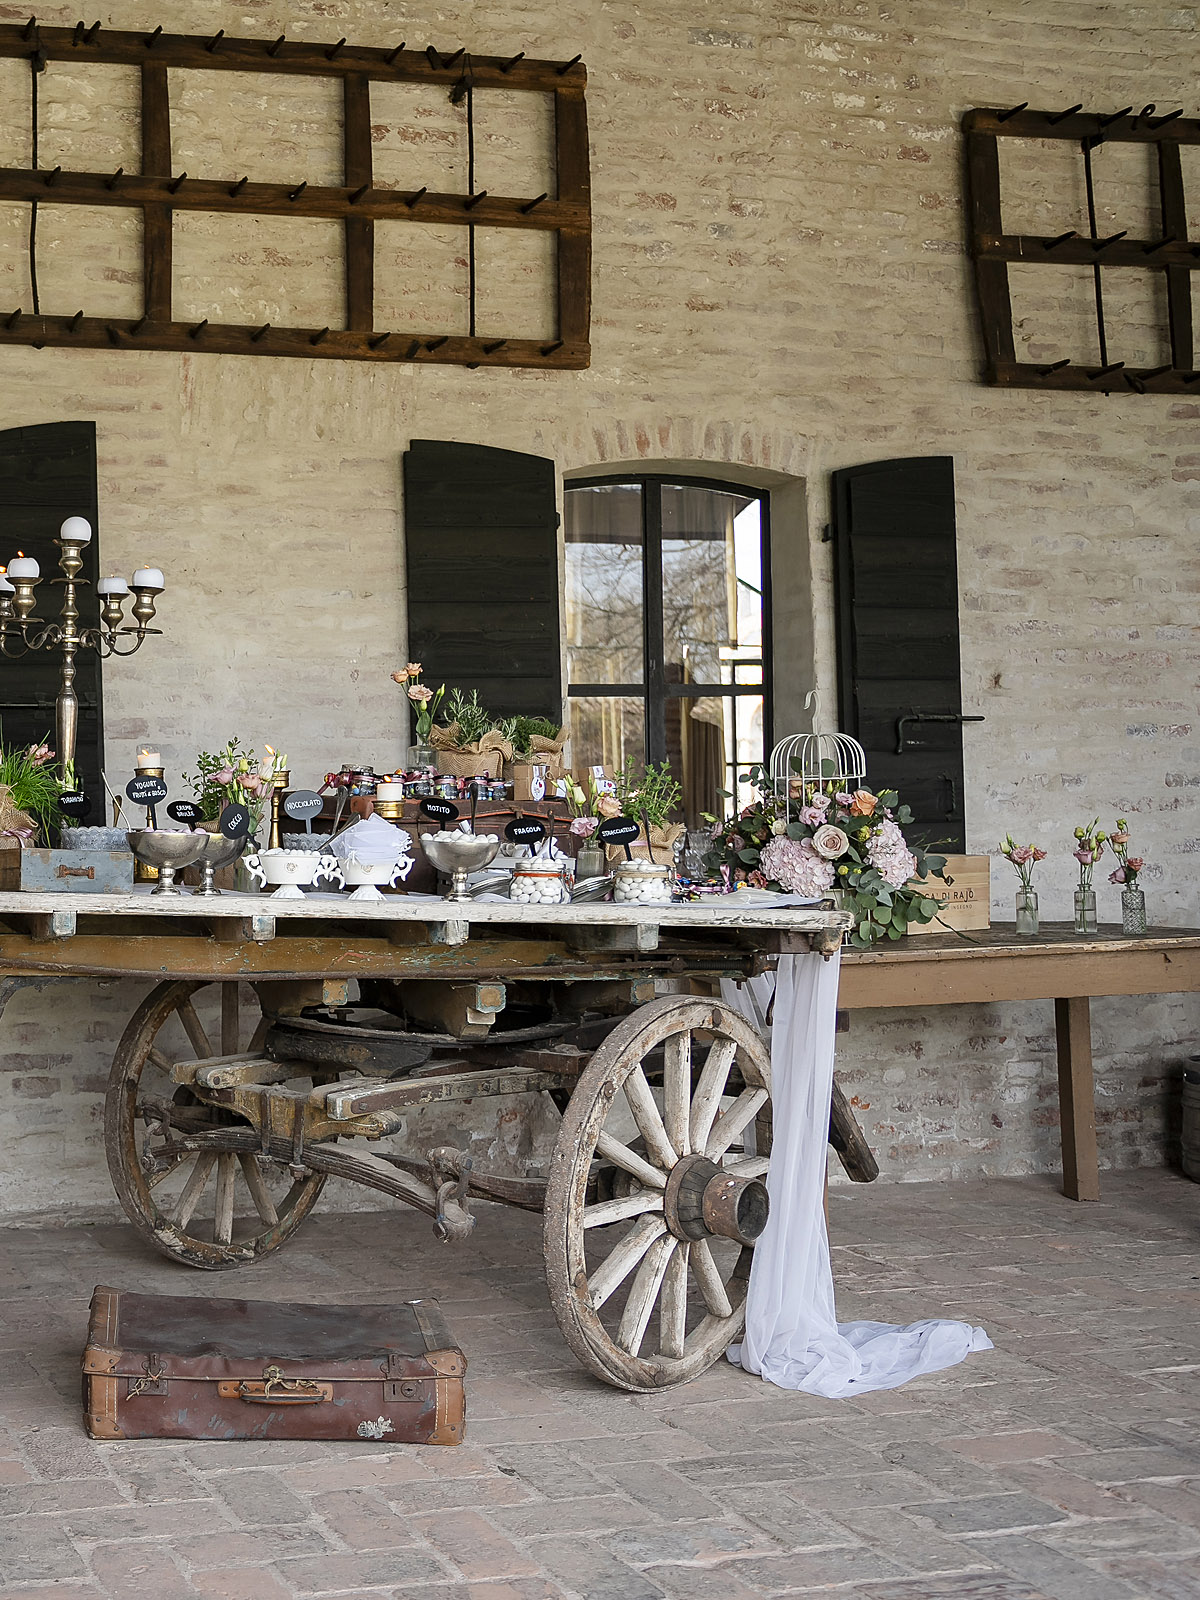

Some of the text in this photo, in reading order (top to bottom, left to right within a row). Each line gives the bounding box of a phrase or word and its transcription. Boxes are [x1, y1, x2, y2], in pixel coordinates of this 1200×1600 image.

[134, 780, 157, 790] YOGURT
[287, 799, 321, 810] NOCCIOLATO
[427, 804, 450, 814] MOJITO
[228, 814, 243, 830] COCCO
[514, 826, 541, 836] FRAGOLA
[601, 826, 637, 837] STRACCIATELLA
